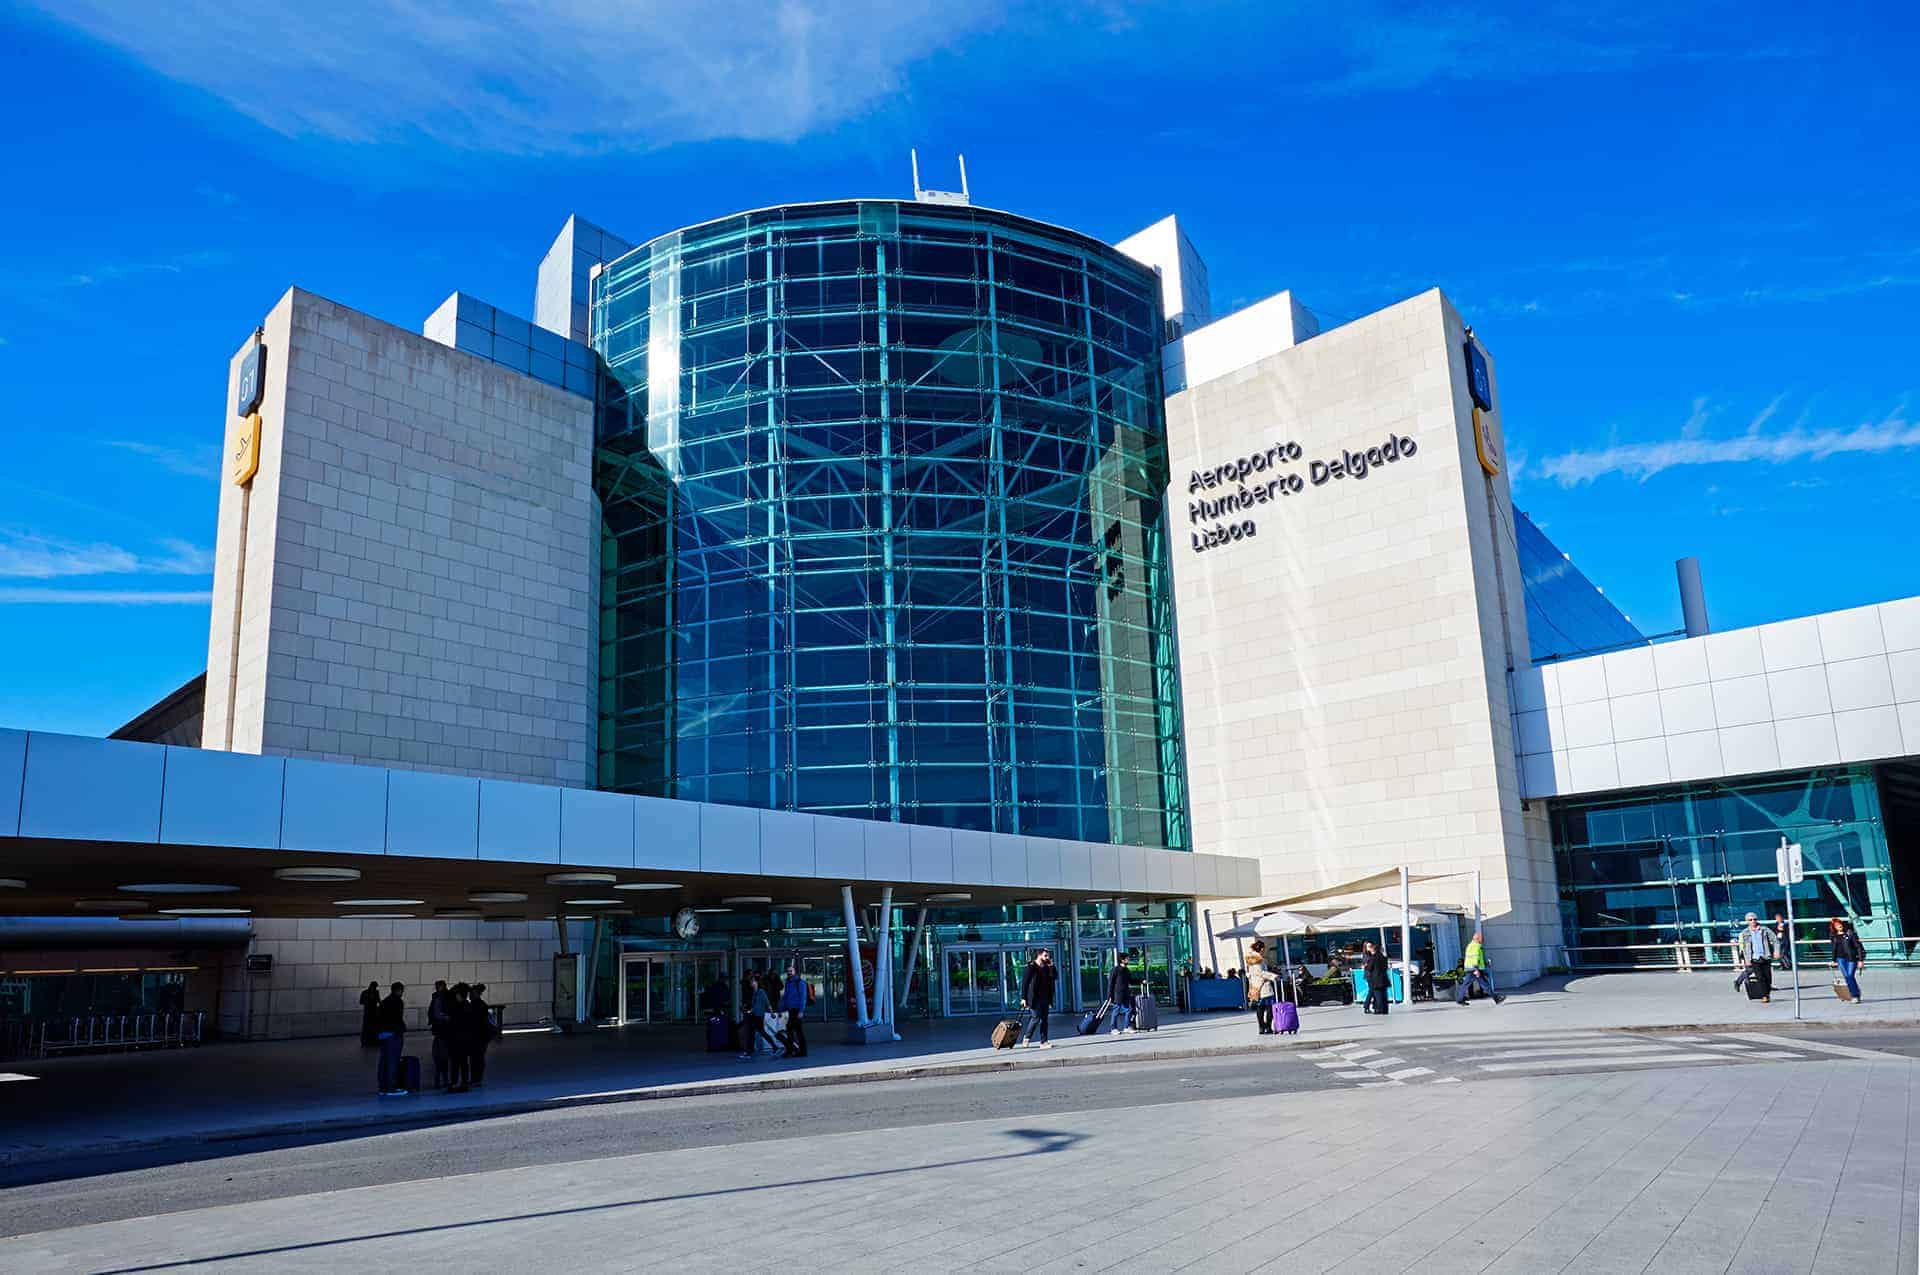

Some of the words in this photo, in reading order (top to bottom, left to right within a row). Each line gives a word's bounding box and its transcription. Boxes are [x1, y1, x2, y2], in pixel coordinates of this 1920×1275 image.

[1188, 441, 1302, 494] Aeroporto
[1188, 473, 1304, 524] Humberto
[1309, 433, 1417, 485] Delgado
[1191, 519, 1256, 552] Lisboa
